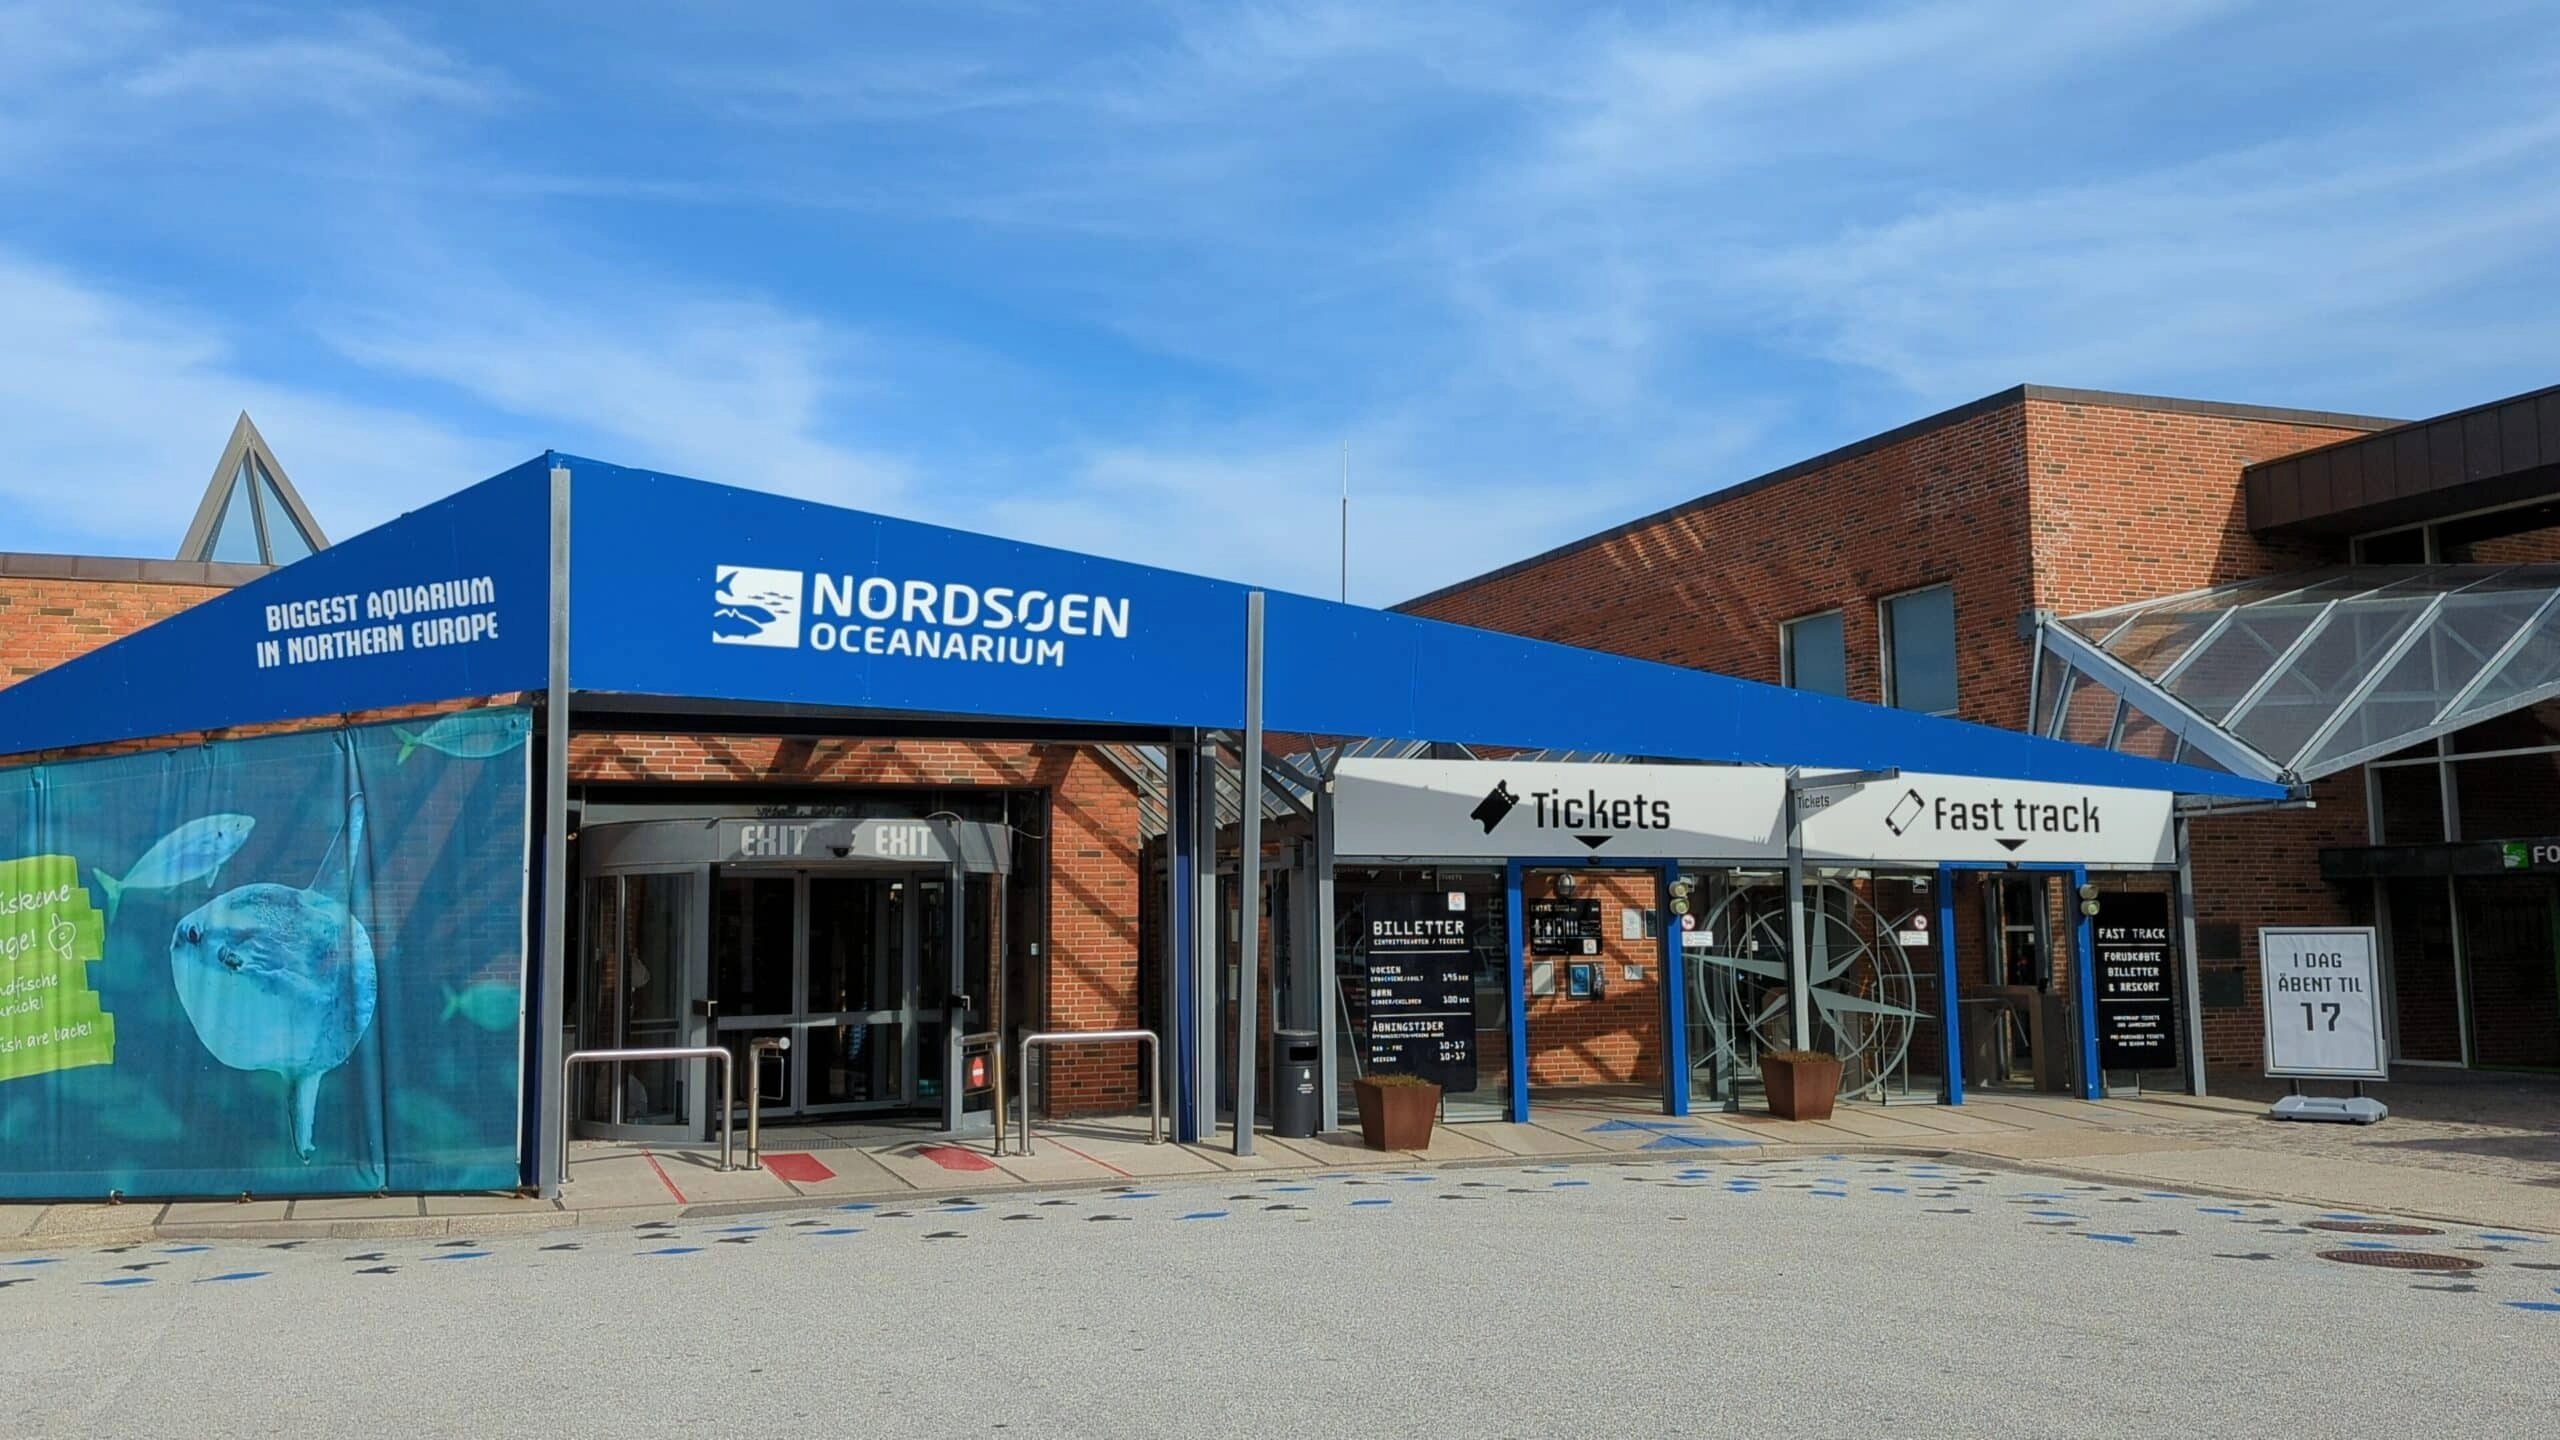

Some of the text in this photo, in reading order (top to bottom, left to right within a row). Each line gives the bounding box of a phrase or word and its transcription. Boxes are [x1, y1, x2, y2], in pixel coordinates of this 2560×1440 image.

[265, 575, 495, 632] BIGGEST AQUARIUM
[811, 572, 1130, 639] NORDSØEN
[256, 611, 499, 668] IN NORTHERN EUROPE
[810, 621, 1065, 668] OCEANARIUM
[1531, 788, 1671, 830] Tickets
[1797, 795, 1830, 809] Tickets
[1934, 796, 2101, 833] Fast track
[741, 825, 808, 857] EXIT
[875, 825, 932, 857] EXIT
[0, 884, 70, 915] iskene
[1373, 920, 1464, 936] BILLETTER
[2098, 928, 2166, 939] FAST TRACK
[1370, 966, 1402, 975] VOKSEN
[2107, 967, 2160, 977] BILLETTER
[2294, 952, 2342, 968] I DAG
[2338, 977, 2363, 992] TIL
[1372, 1021, 1444, 1032] ÅBNINGSTIDER
[2300, 1002, 2341, 1032] 17
[27, 1032, 49, 1048] are
[53, 1020, 93, 1042] back!
